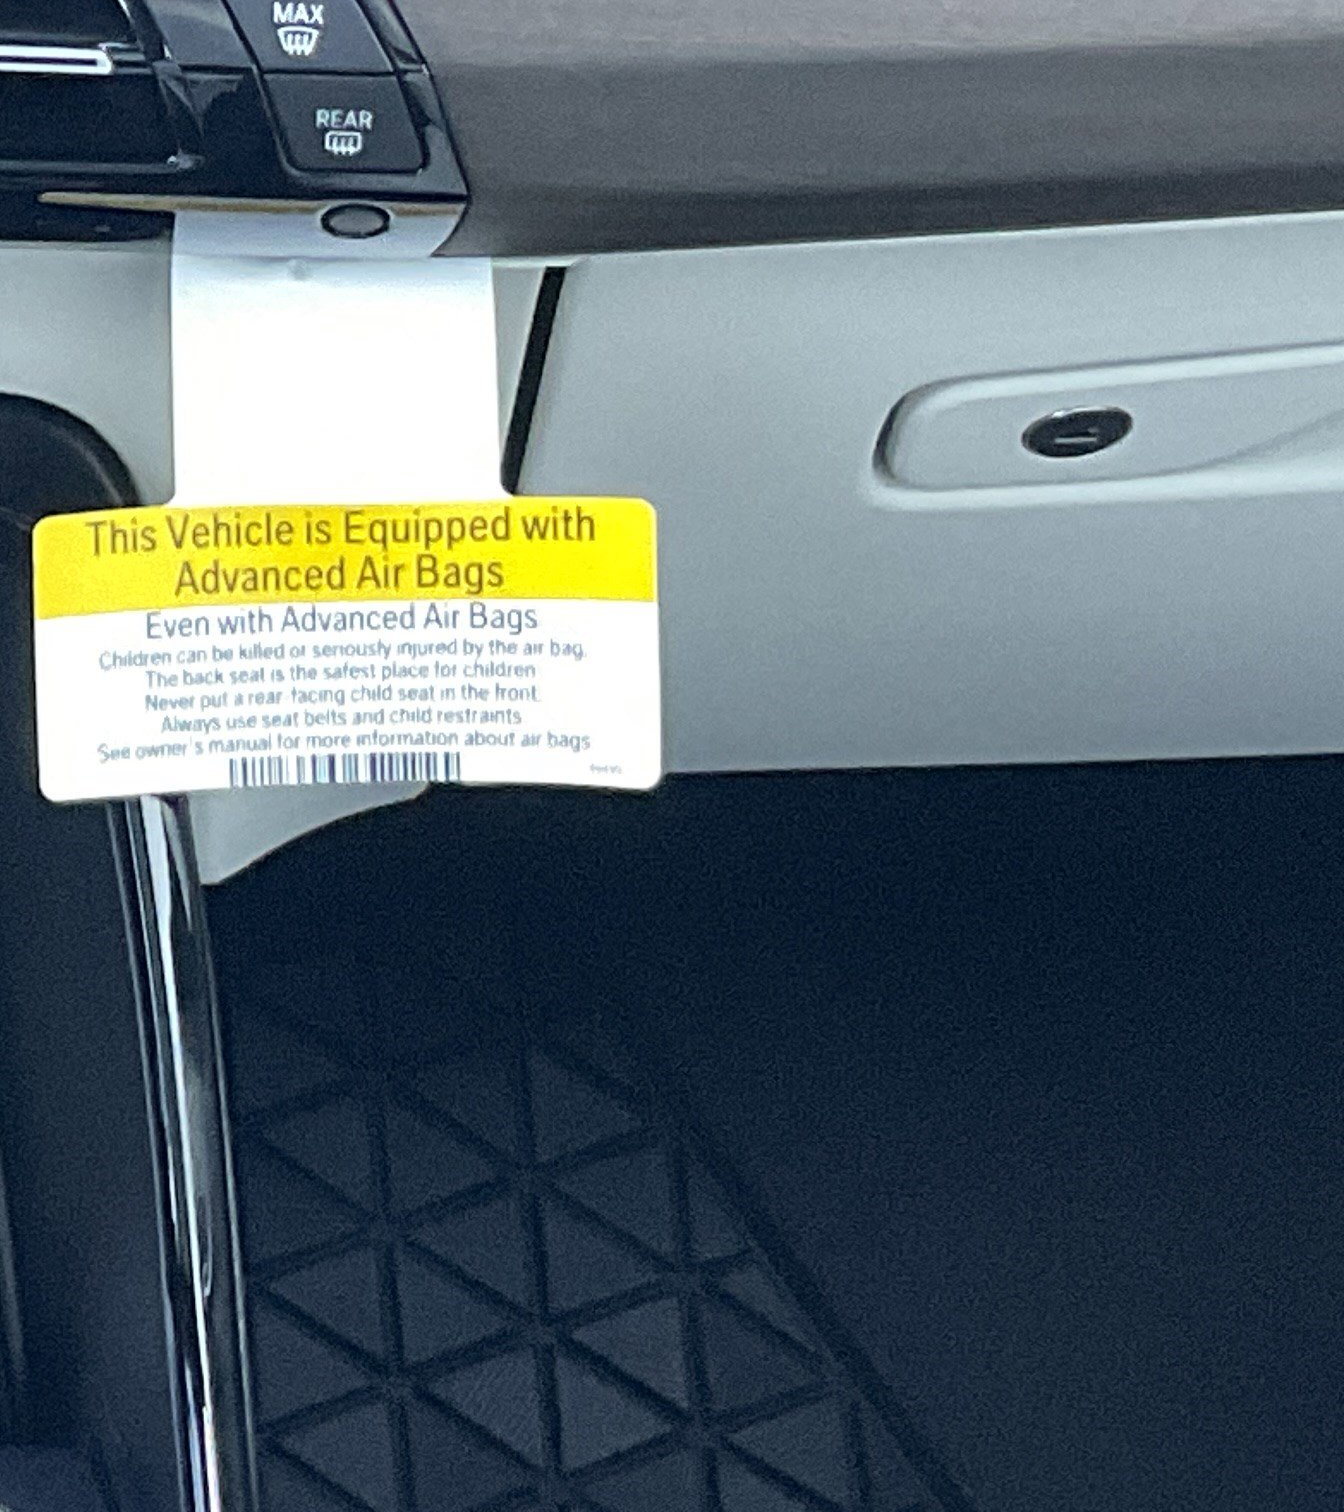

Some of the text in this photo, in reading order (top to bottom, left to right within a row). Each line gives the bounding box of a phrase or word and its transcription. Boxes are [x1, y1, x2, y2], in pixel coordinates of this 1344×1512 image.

[273, 1, 324, 26] MAX
[315, 109, 373, 130] REAR
[85, 504, 596, 558] This Vehicle is Equipped with
[174, 552, 504, 598] Advanced Air Bags
[146, 601, 538, 639] Even with Advanced Air Bags
[99, 648, 172, 671] Children
[176, 649, 207, 664] can
[212, 645, 234, 662] be
[239, 643, 285, 660] killed
[290, 644, 306, 659] or
[313, 639, 391, 660] seriously
[397, 639, 457, 660] injured
[463, 639, 484, 660] by
[489, 639, 517, 655] the
[523, 640, 544, 656] air
[146, 670, 178, 689] The
[183, 668, 224, 686] back
[229, 667, 264, 685] seat
[271, 668, 284, 682] is
[290, 664, 317, 681] the
[323, 661, 376, 680] safest
[382, 662, 429, 681] place
[435, 661, 457, 678] for
[145, 693, 195, 712] Never
[200, 691, 228, 712] put
[234, 693, 243, 707] a
[351, 684, 392, 702] child
[399, 684, 435, 701] seat
[440, 686, 456, 701] in
[461, 684, 489, 700] the
[162, 715, 221, 734] Always
[227, 716, 257, 731] use
[262, 711, 298, 728] seat
[304, 709, 346, 727] belts
[352, 708, 384, 726] and
[389, 708, 432, 724] child
[97, 744, 131, 763] See
[135, 737, 203, 760] owner's
[208, 733, 272, 754] manual
[277, 733, 300, 749] for
[306, 733, 351, 749] more
[356, 730, 459, 747] information
[464, 729, 515, 747] about
[520, 731, 542, 746] air
